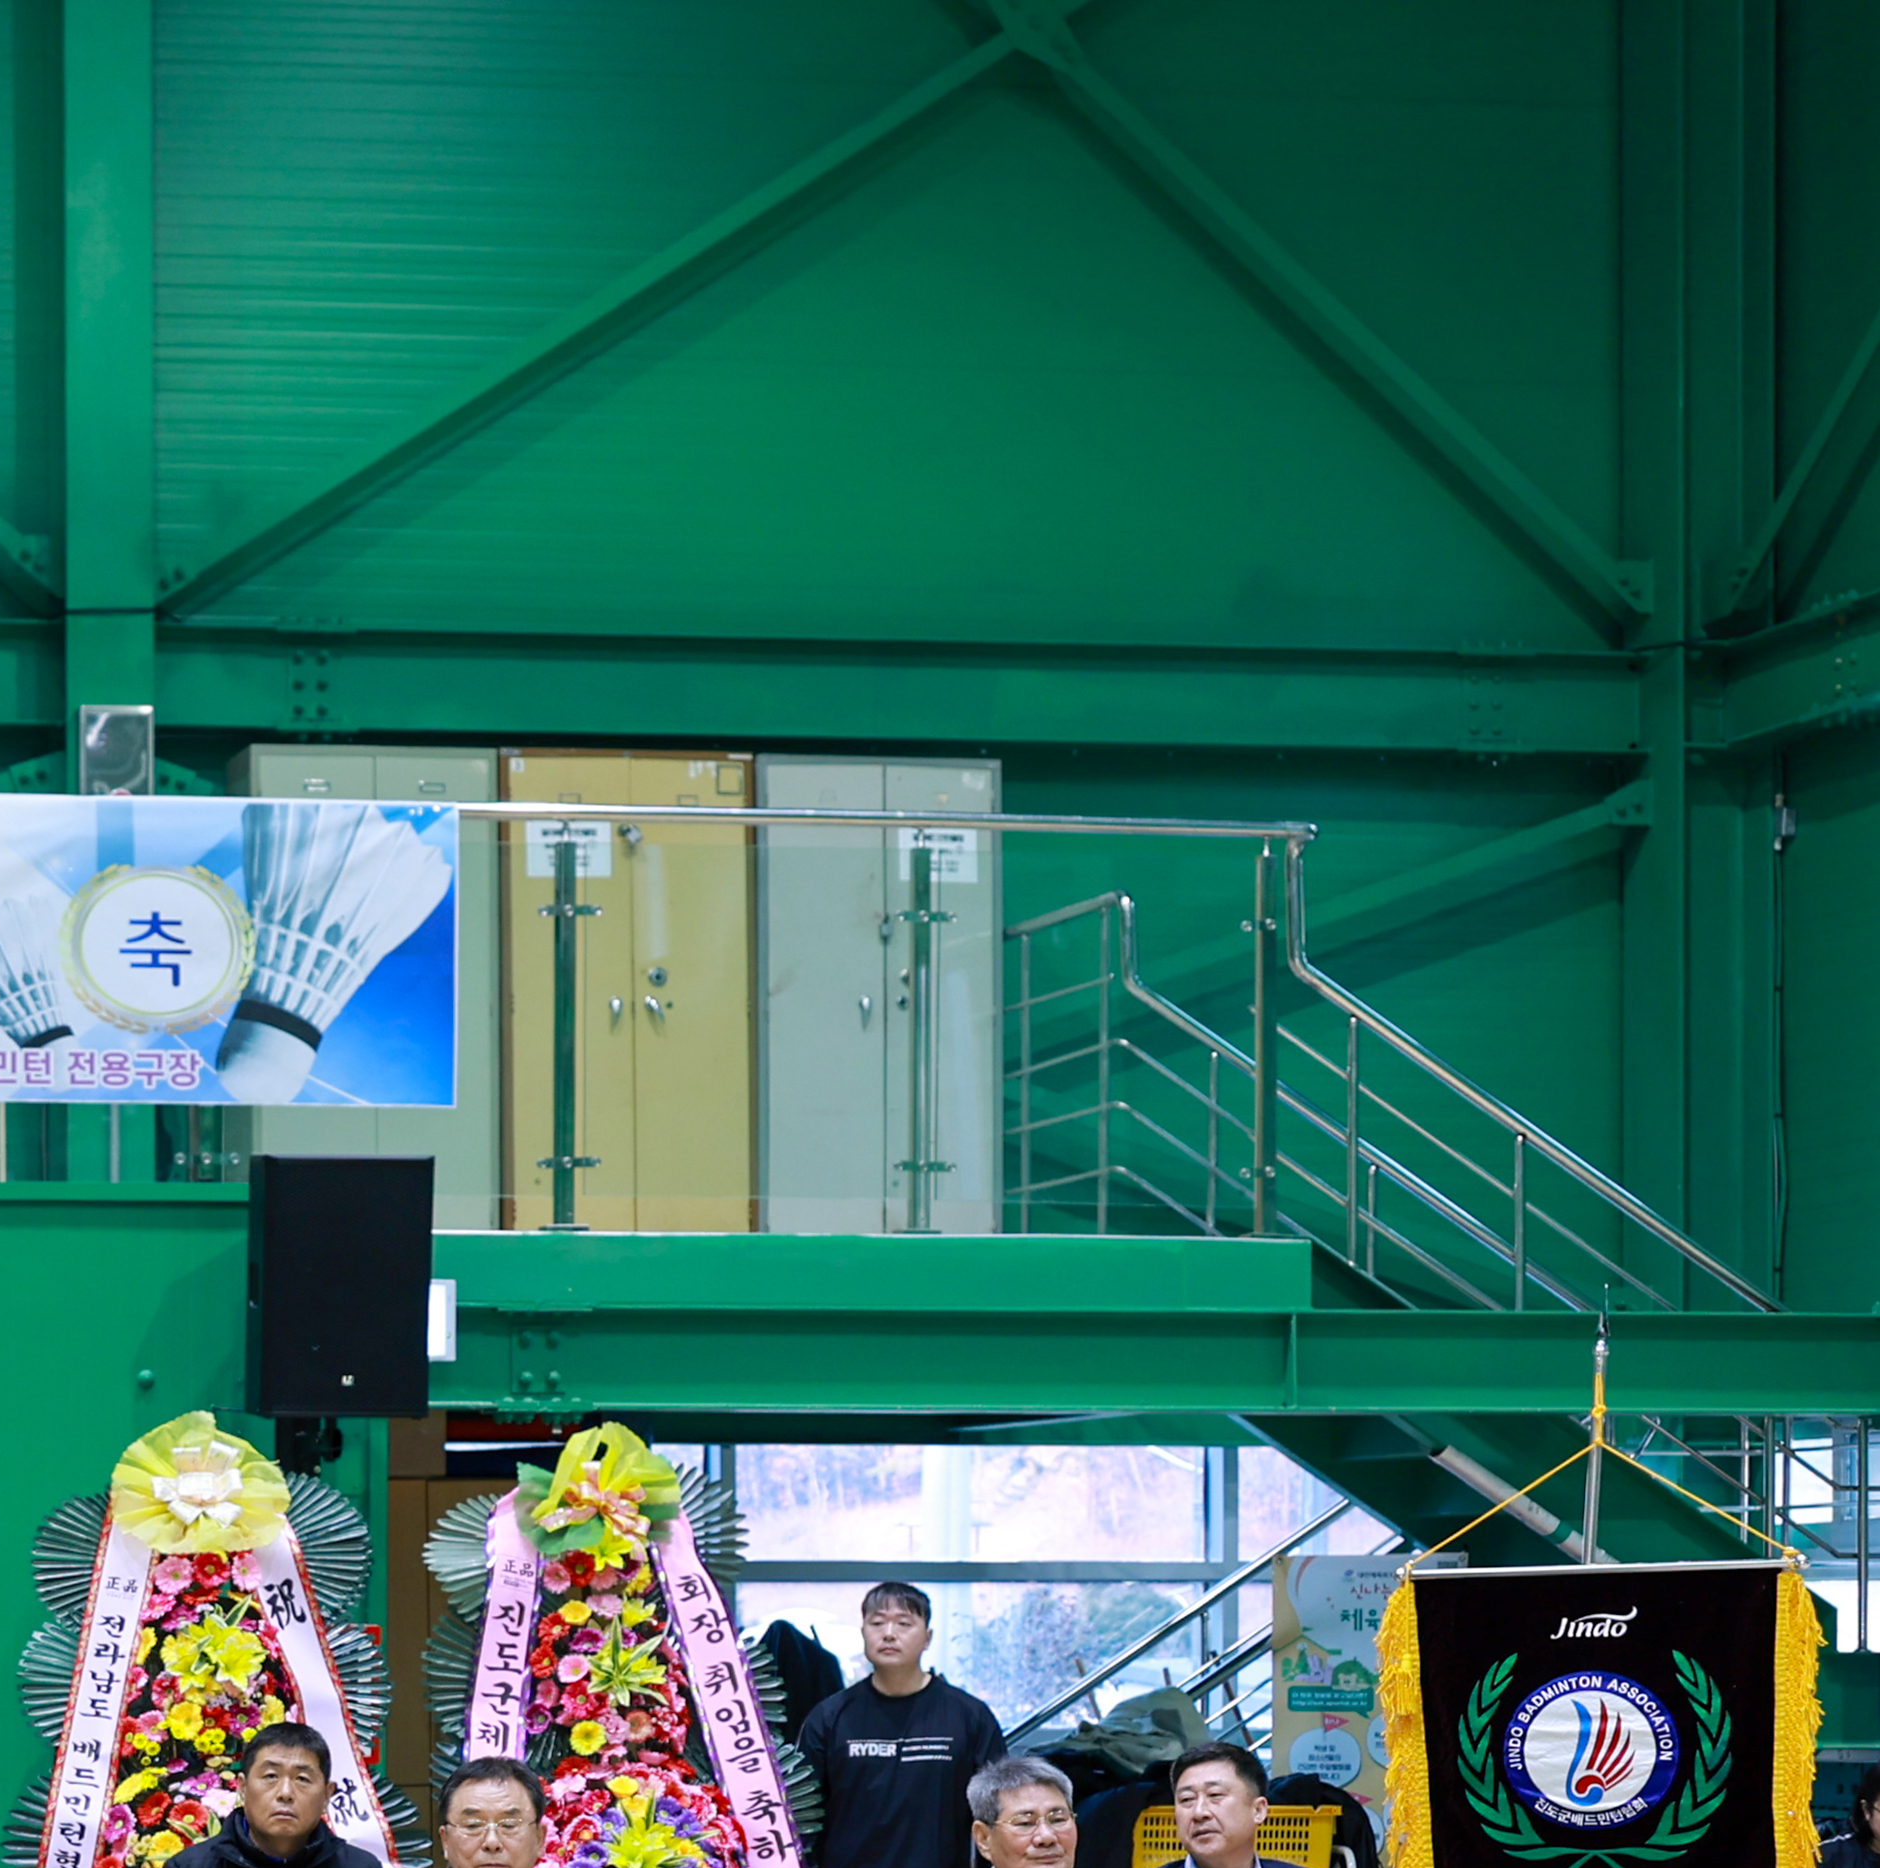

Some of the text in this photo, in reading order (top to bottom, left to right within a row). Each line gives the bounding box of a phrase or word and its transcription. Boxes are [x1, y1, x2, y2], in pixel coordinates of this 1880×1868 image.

[118, 911, 192, 988] 축
[66, 1050, 201, 1087] 전용구장
[501, 1558, 535, 1578] 正品
[264, 1577, 308, 1632] 祝
[678, 1572, 731, 1644] 회장
[1549, 1613, 1629, 1640] Jindo
[78, 1613, 128, 1721] 전라남도
[704, 1662, 767, 1774] 취임을
[1508, 1675, 1674, 1771] JINDO BADMINTON ASSOCIATION
[848, 1743, 897, 1758] RYDER
[1534, 1796, 1649, 1827] 진도군배드민턴협회
